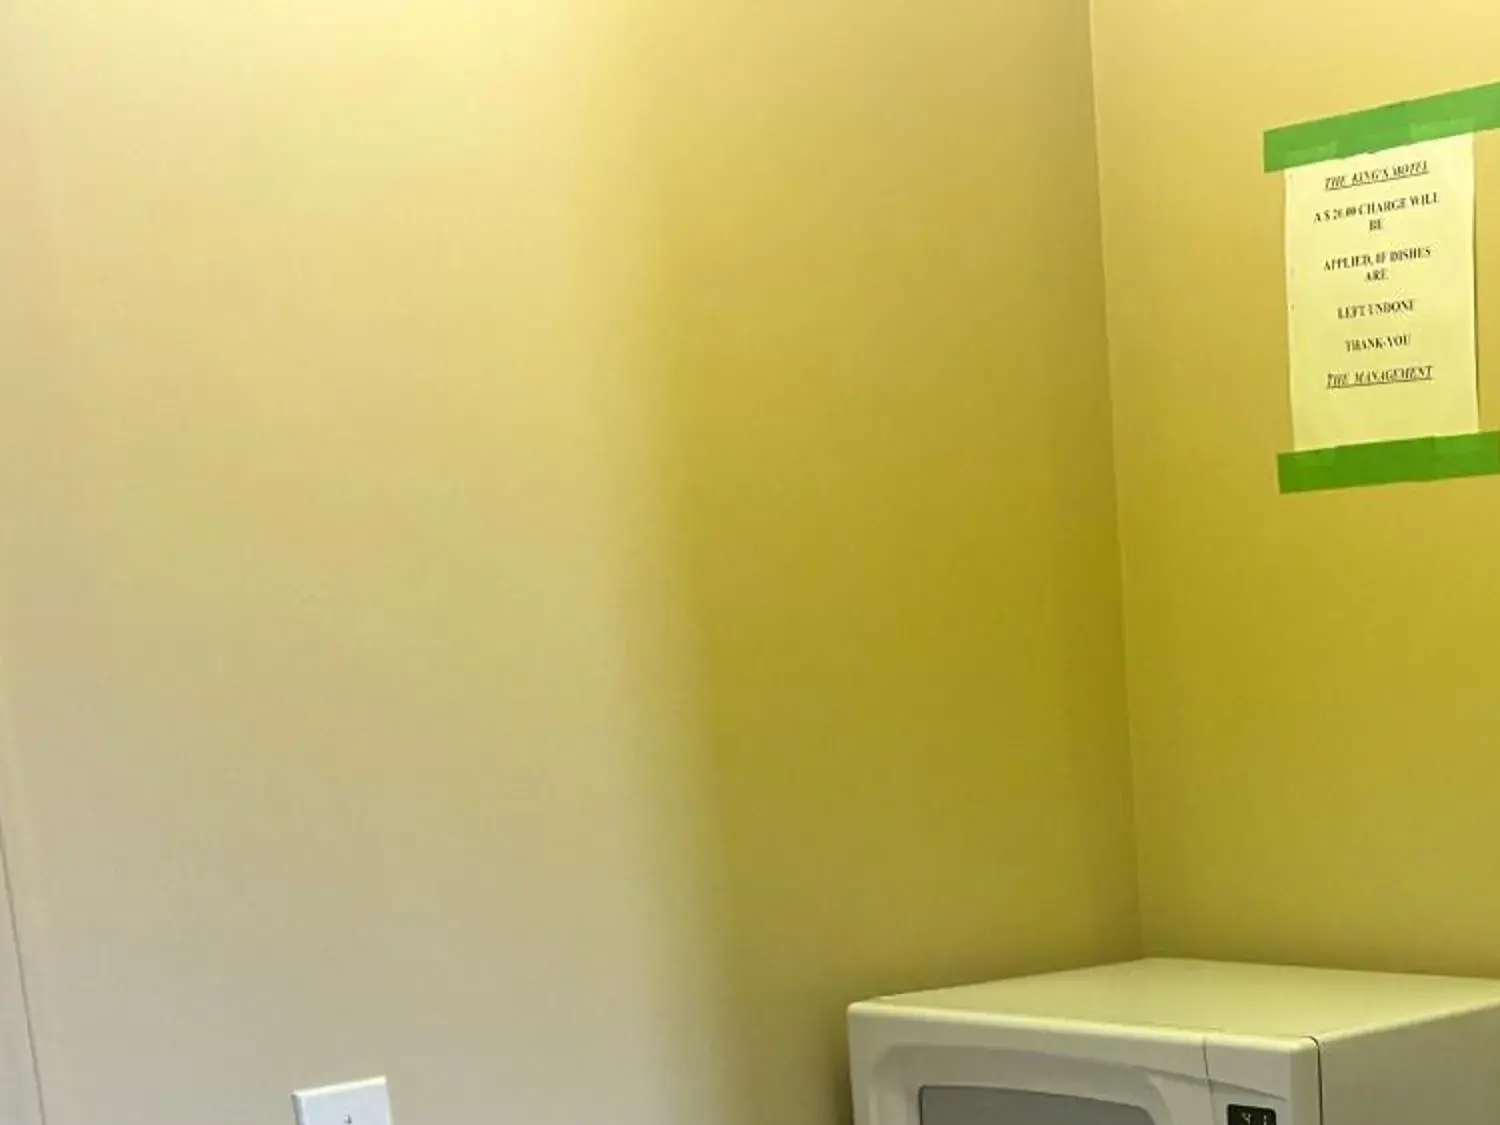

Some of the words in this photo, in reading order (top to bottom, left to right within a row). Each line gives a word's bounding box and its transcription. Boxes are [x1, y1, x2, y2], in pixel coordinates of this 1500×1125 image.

[1325, 175, 1348, 191] THE
[1358, 197, 1407, 217] CHARGE
[1408, 191, 1440, 208] WILL
[1368, 218, 1384, 232] BE
[1389, 246, 1432, 264] DISHES
[1364, 268, 1389, 282] ARE
[1336, 304, 1366, 320] LEFT
[1367, 299, 1416, 316] UNDONE
[1327, 372, 1348, 389] THE
[1354, 364, 1434, 386] MANAGEMENT
